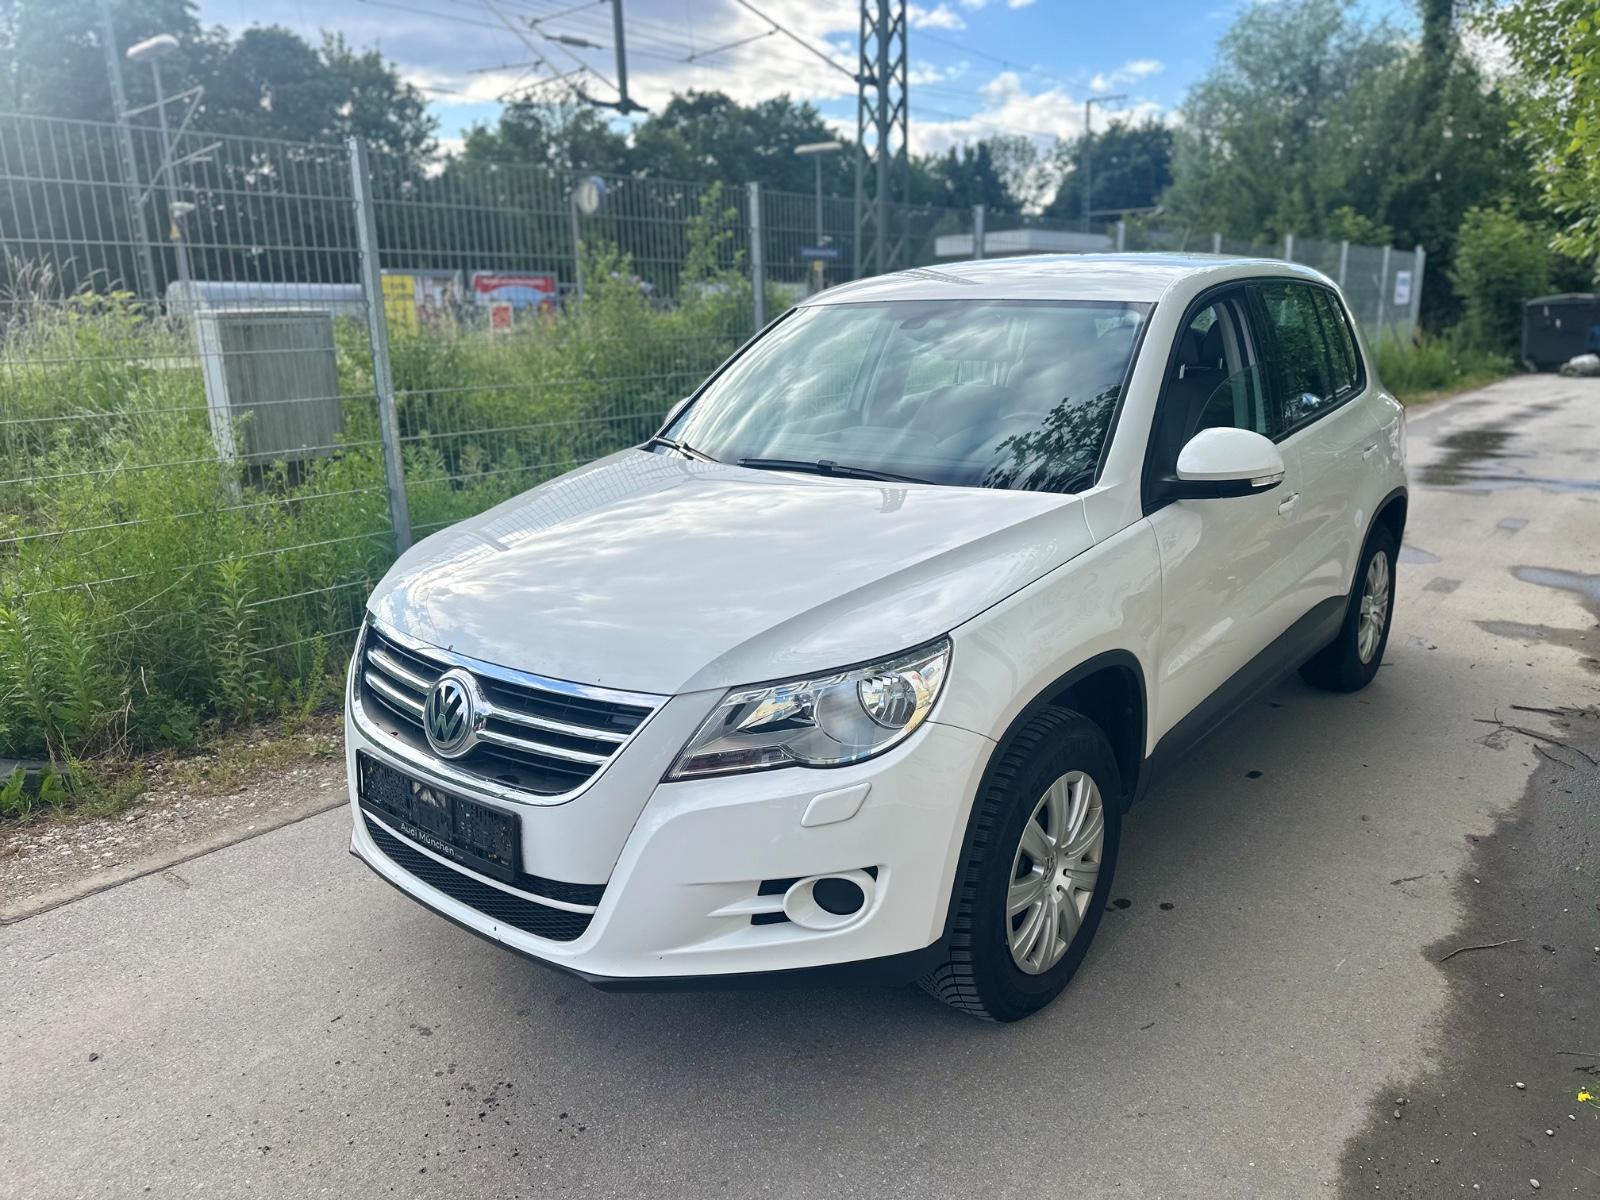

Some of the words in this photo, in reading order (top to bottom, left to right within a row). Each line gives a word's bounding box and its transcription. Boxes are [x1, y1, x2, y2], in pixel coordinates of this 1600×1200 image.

[428, 678, 471, 747] VW
[400, 822, 418, 839] Audi
[419, 831, 455, 856] München
